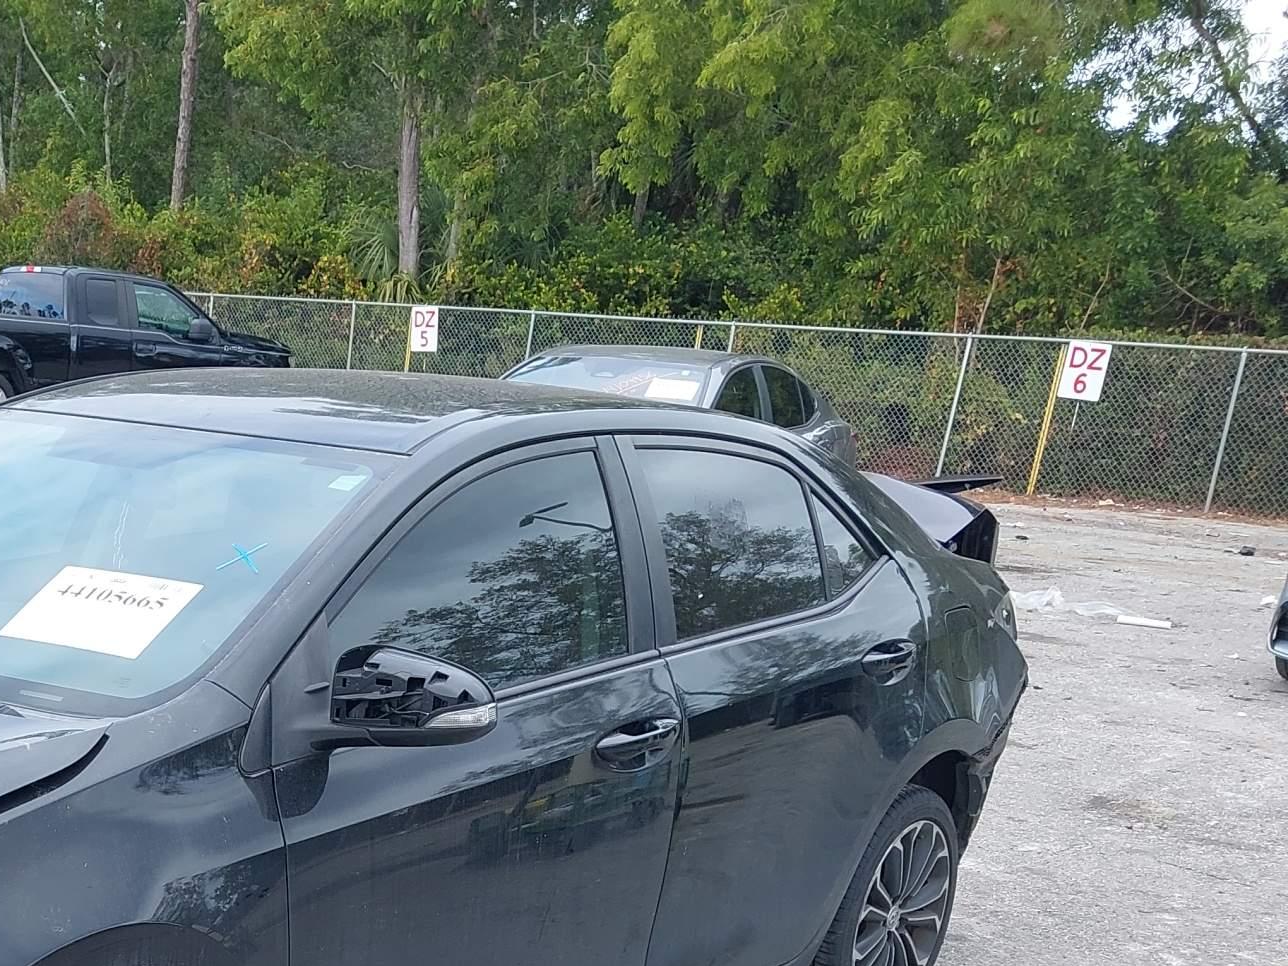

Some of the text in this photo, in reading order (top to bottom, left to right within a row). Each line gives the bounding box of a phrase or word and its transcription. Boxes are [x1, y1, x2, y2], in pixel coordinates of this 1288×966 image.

[415, 311, 436, 328] DZ
[420, 330, 429, 348] 5
[1069, 346, 1107, 371] DZ
[1073, 373, 1088, 394] 6
[57, 583, 169, 611] 44105665
